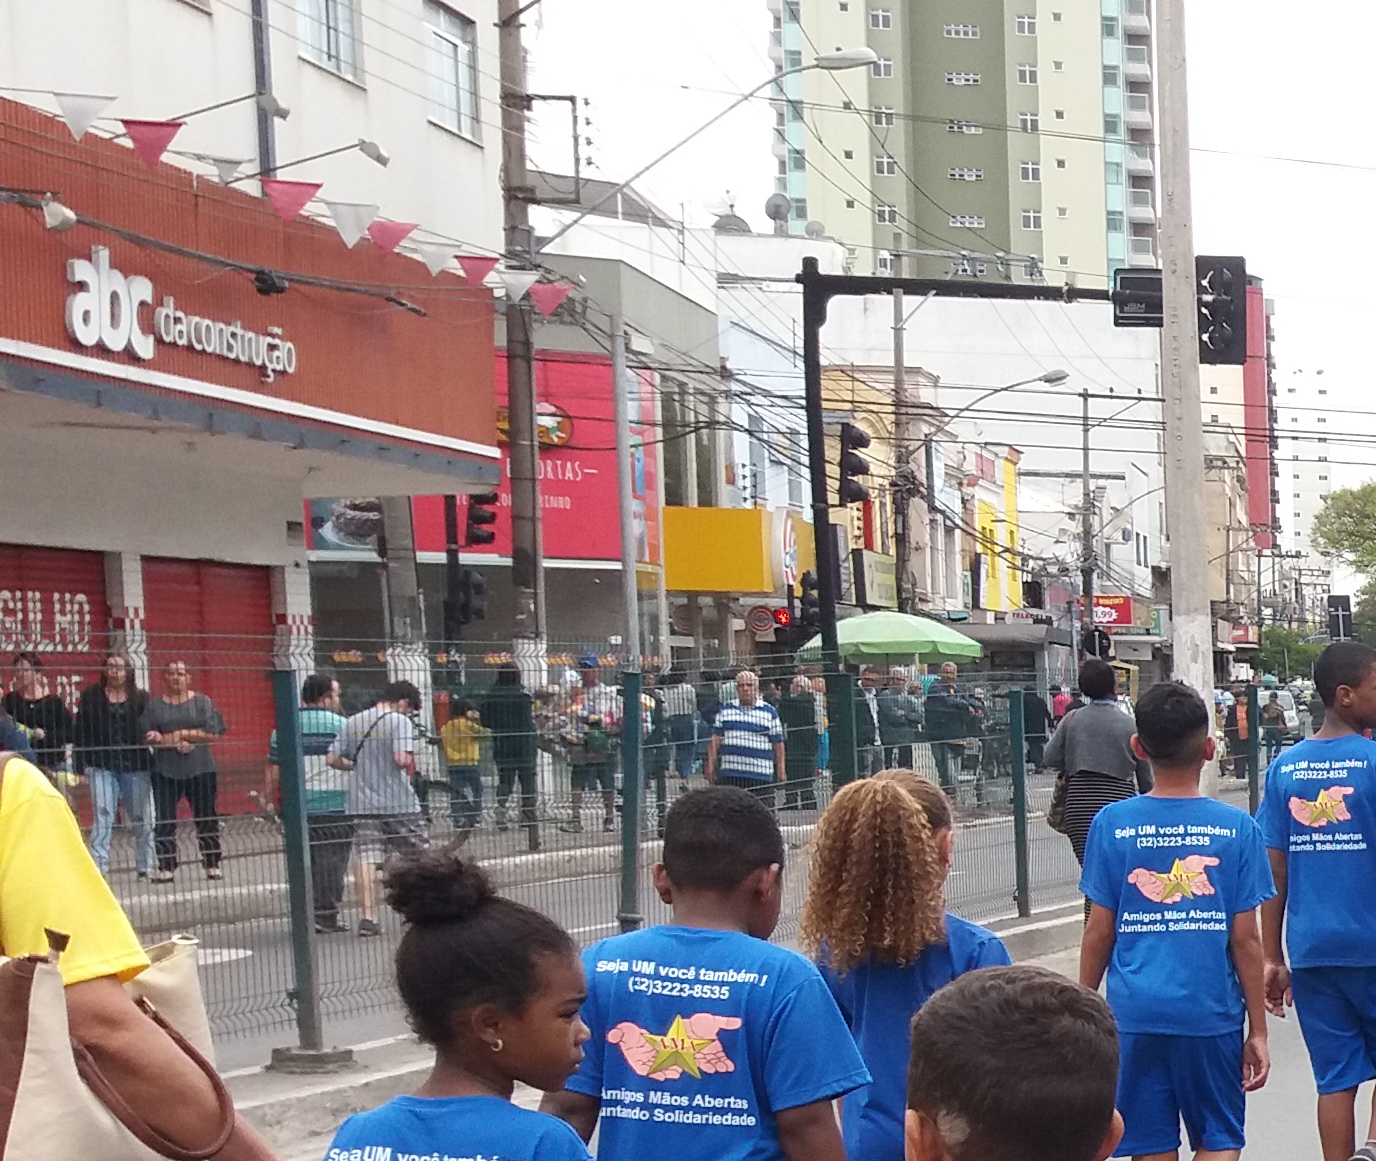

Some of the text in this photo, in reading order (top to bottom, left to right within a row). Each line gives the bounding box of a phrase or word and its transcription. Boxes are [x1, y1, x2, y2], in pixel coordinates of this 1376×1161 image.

[66, 245, 296, 383] abc da construção
[1310, 760, 1330, 769] você
[1332, 759, 1362, 769] também
[1138, 824, 1156, 835] UM
[1158, 824, 1184, 835] você
[1187, 824, 1231, 837] também
[1136, 836, 1210, 849] (32)3223-8535
[1122, 911, 1161, 922] Amigos
[1188, 909, 1227, 920] Abertas
[1119, 922, 1167, 933] Juntando
[632, 959, 656, 975] UM
[658, 964, 695, 980] você
[699, 967, 759, 984] também
[628, 976, 730, 1000] (32)3223-8535
[648, 1089, 689, 1107] Mãos
[692, 1094, 749, 1110] Abertas
[600, 1106, 757, 1127] untando Solidariedade
